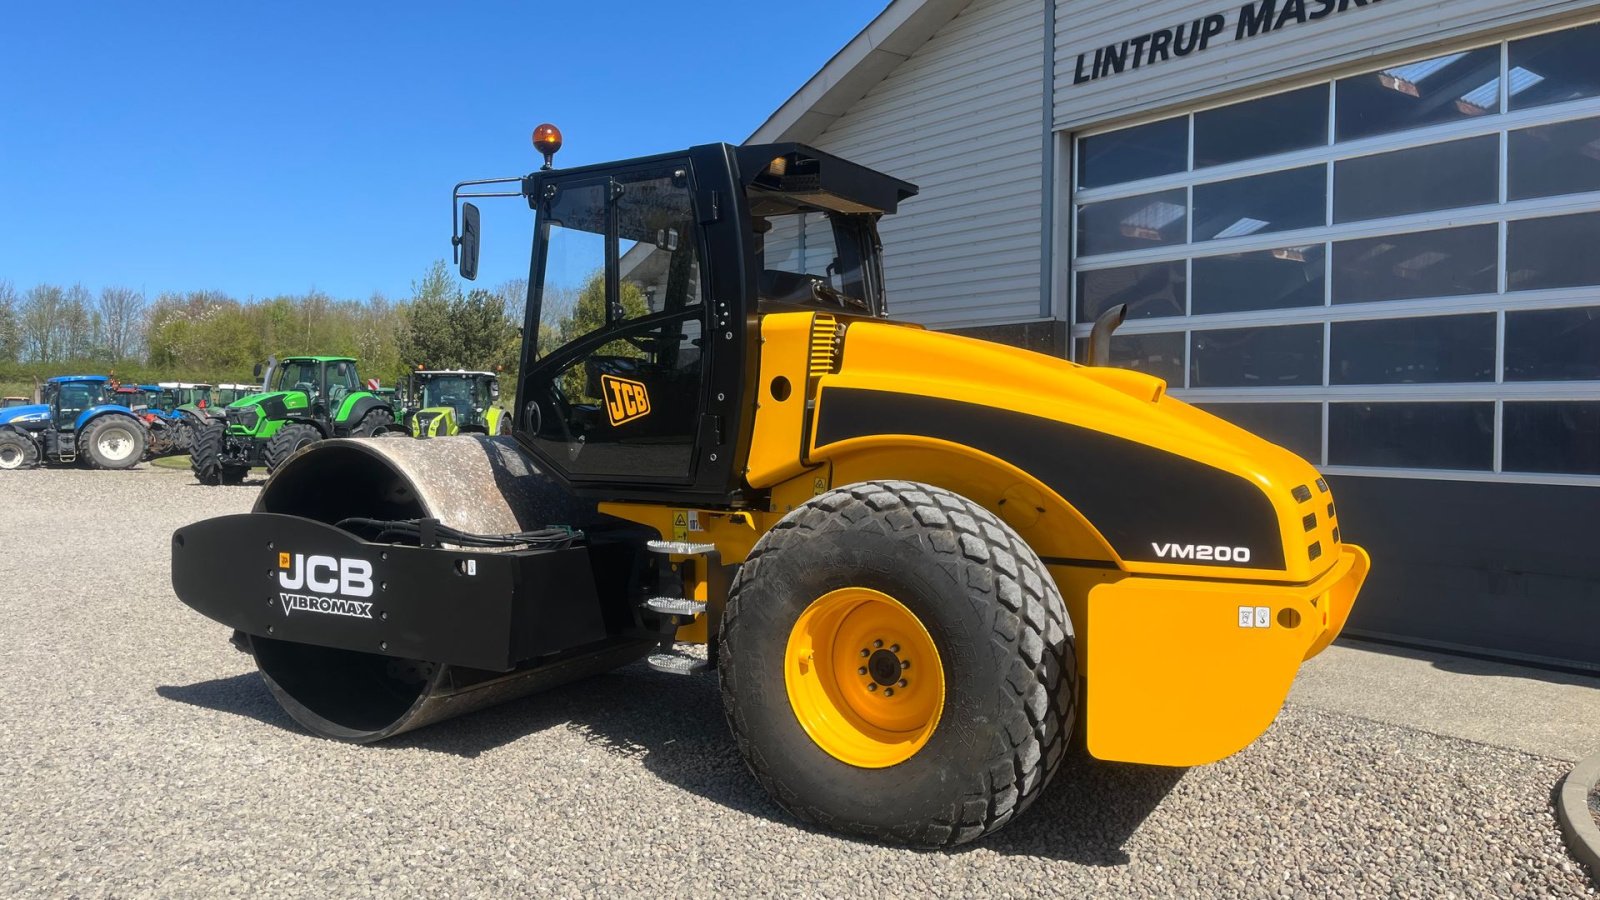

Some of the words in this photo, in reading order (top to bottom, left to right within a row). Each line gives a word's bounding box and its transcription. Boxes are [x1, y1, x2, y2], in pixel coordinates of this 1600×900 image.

[1074, 14, 1224, 84] LINTRUP
[609, 380, 648, 420] JCB
[1151, 542, 1251, 562] VM200
[279, 554, 374, 597] JCB
[279, 592, 374, 619] VIBROMAX
